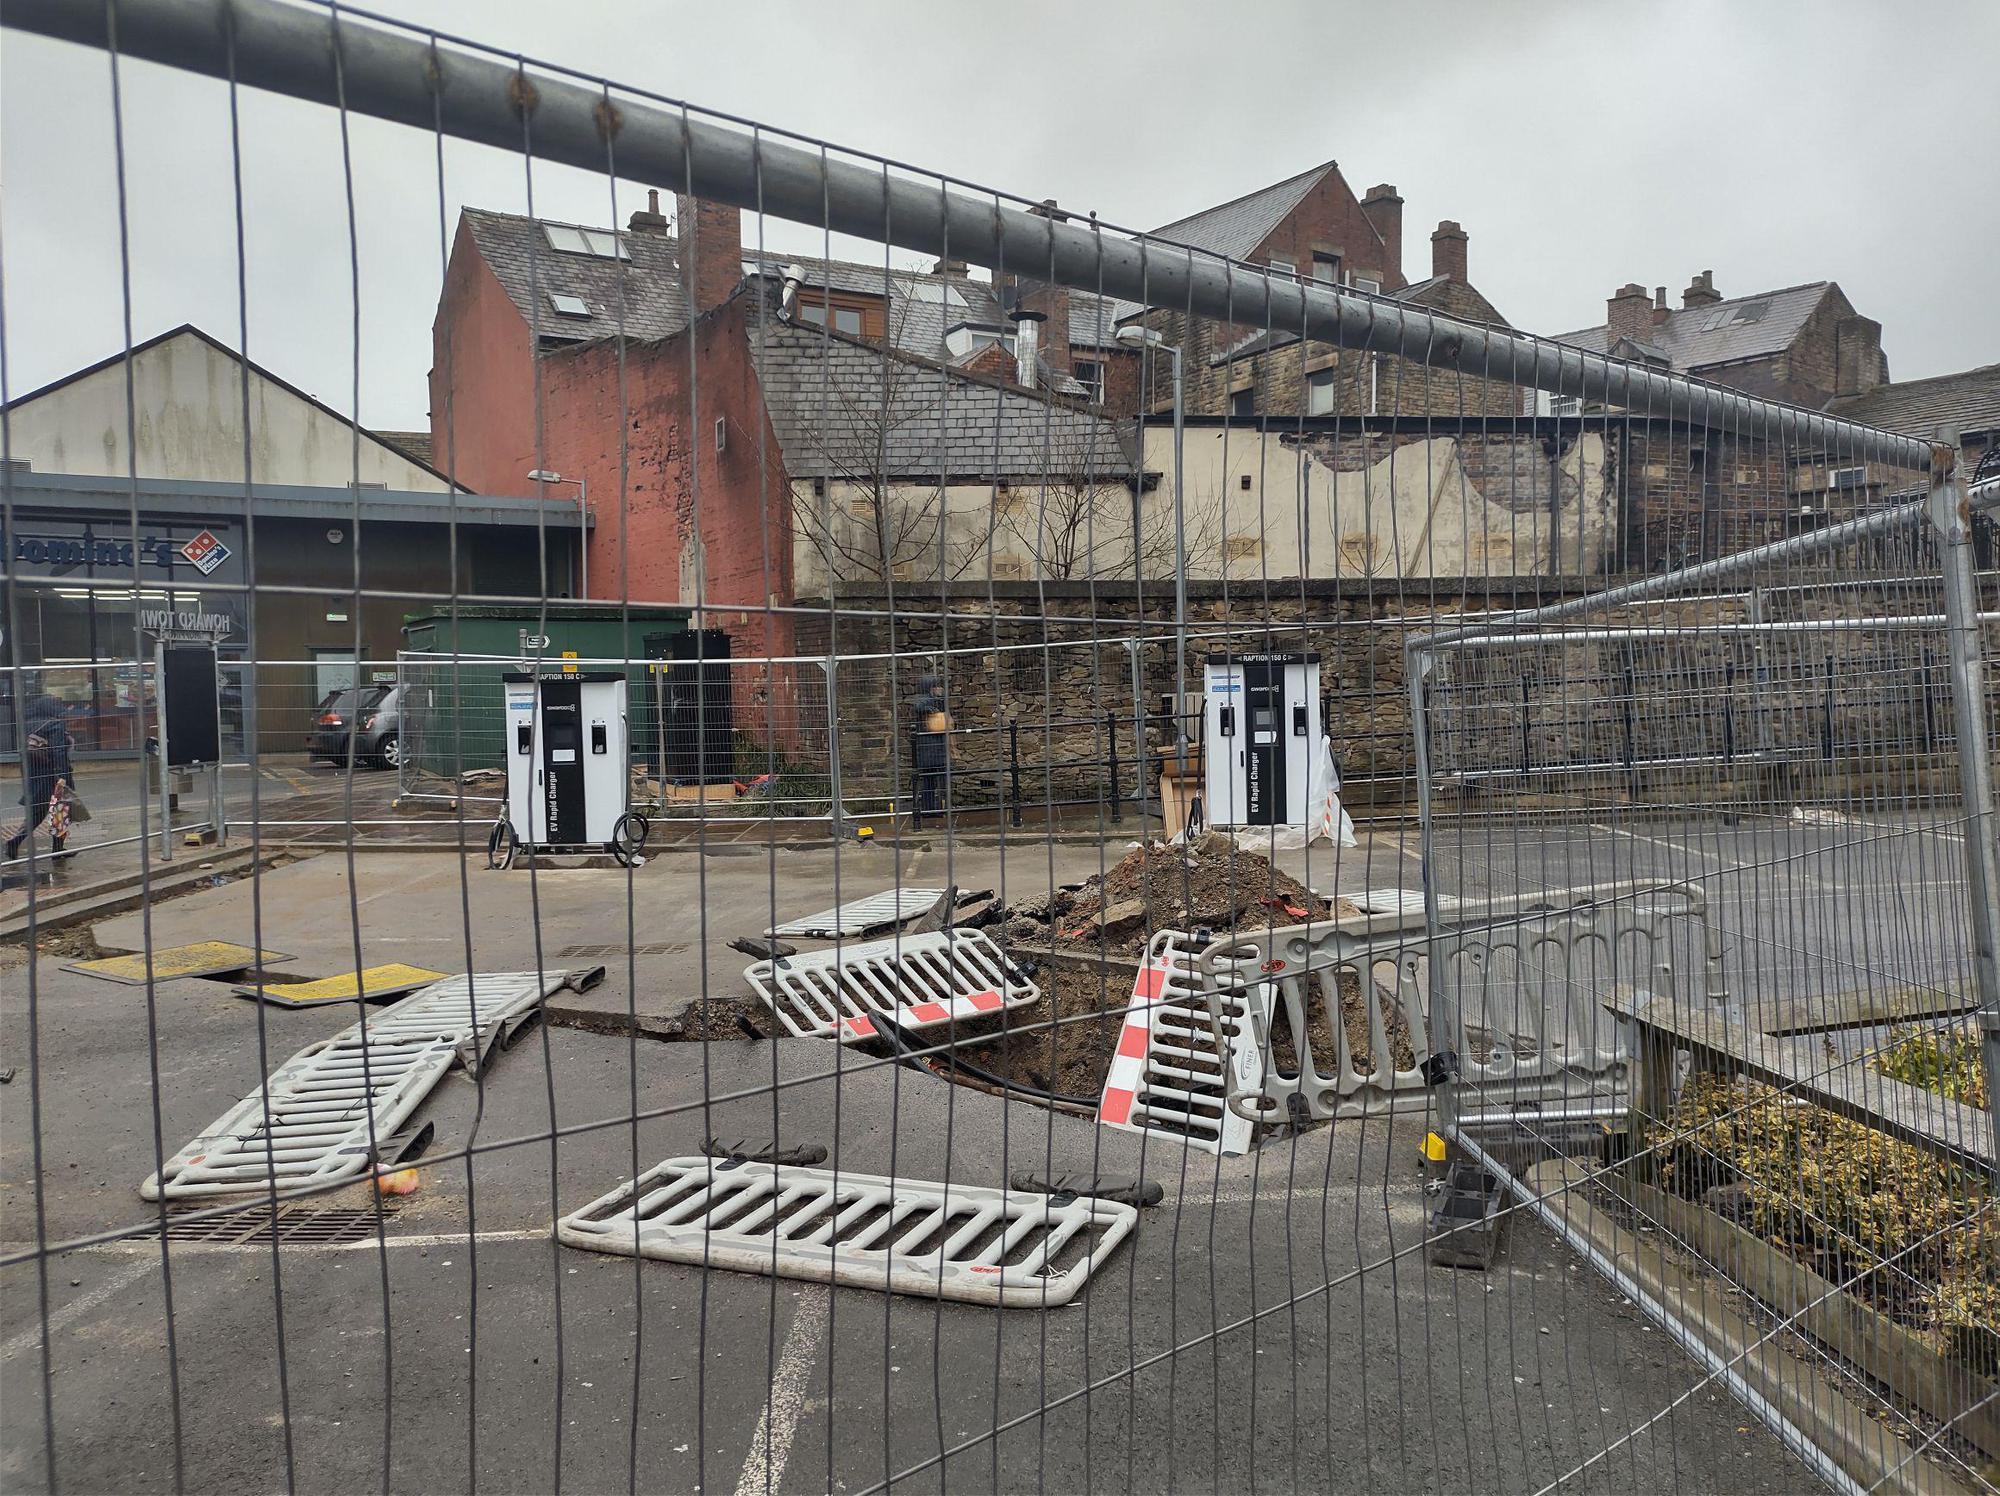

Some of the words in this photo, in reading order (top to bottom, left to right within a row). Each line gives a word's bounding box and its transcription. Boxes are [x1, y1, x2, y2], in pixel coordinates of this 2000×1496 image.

[1251, 751, 1260, 780] Charger
[549, 771, 558, 799] Charger
[1251, 781, 1260, 801] Rapid
[549, 800, 559, 820] Rapid
[1251, 803, 1259, 813] EV
[550, 822, 558, 832] EV
